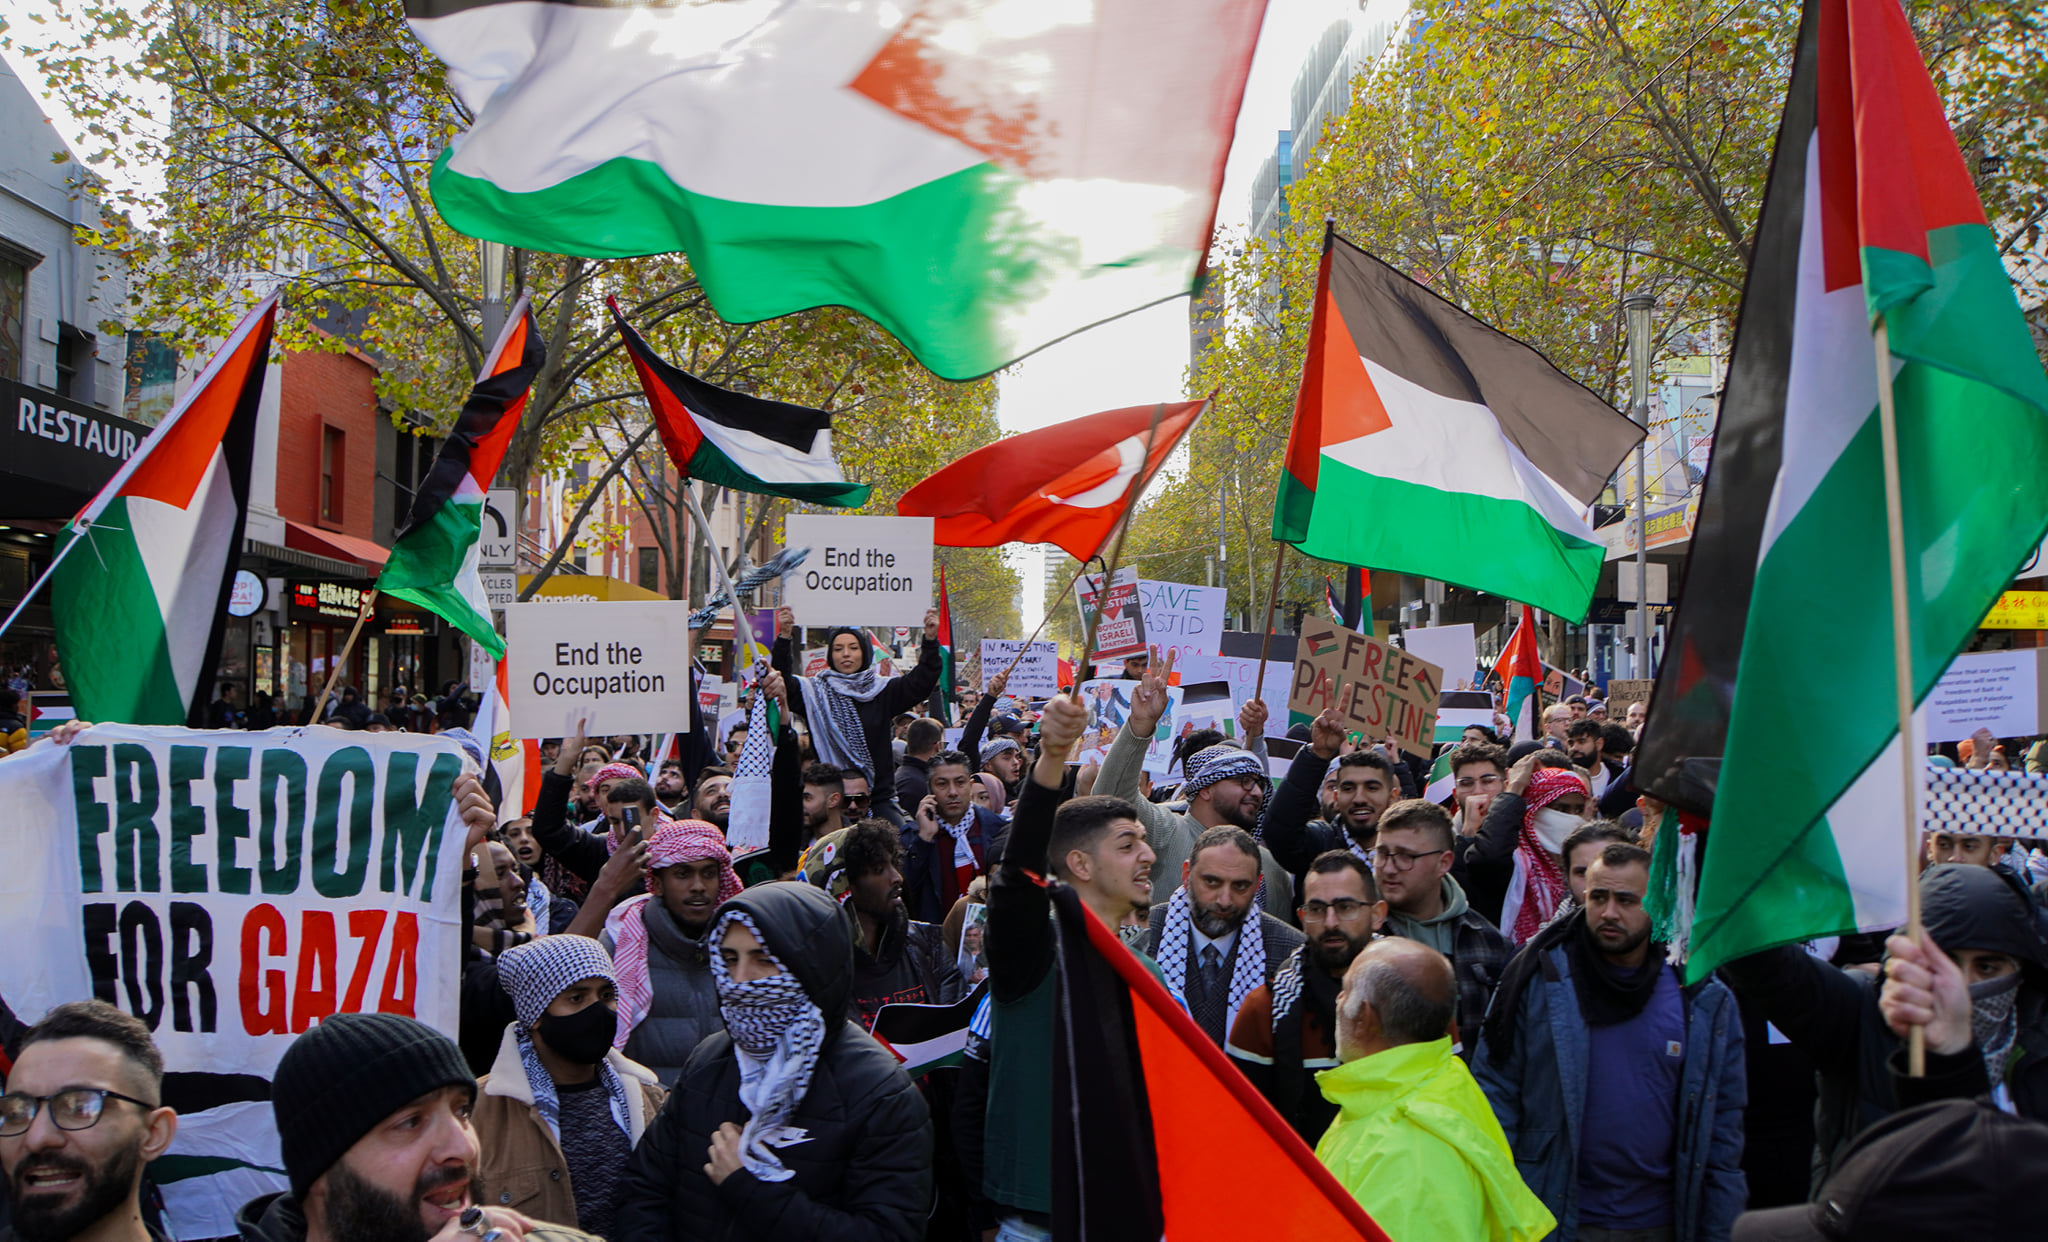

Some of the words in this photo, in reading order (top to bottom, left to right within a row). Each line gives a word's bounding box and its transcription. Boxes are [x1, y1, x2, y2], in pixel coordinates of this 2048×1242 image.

[480, 544, 511, 557] NLY
[825, 548, 860, 567] End
[866, 549, 895, 568] the
[806, 571, 912, 595] Occupation
[489, 594, 513, 604] PTED
[1138, 582, 1203, 611] SAVE
[1097, 619, 1132, 632] BOYCOTT
[1099, 628, 1134, 642] ISRAELI
[1143, 613, 1204, 636] ASJID
[556, 642, 599, 666] End
[606, 642, 643, 665] the
[985, 642, 996, 652] IN
[1100, 637, 1136, 649] APARTHEID
[1342, 634, 1414, 691] FREE
[533, 671, 665, 699] Occupation
[69, 743, 463, 903] FREEDOM
[83, 900, 217, 1034] FOR
[239, 902, 420, 1036] GAZA
